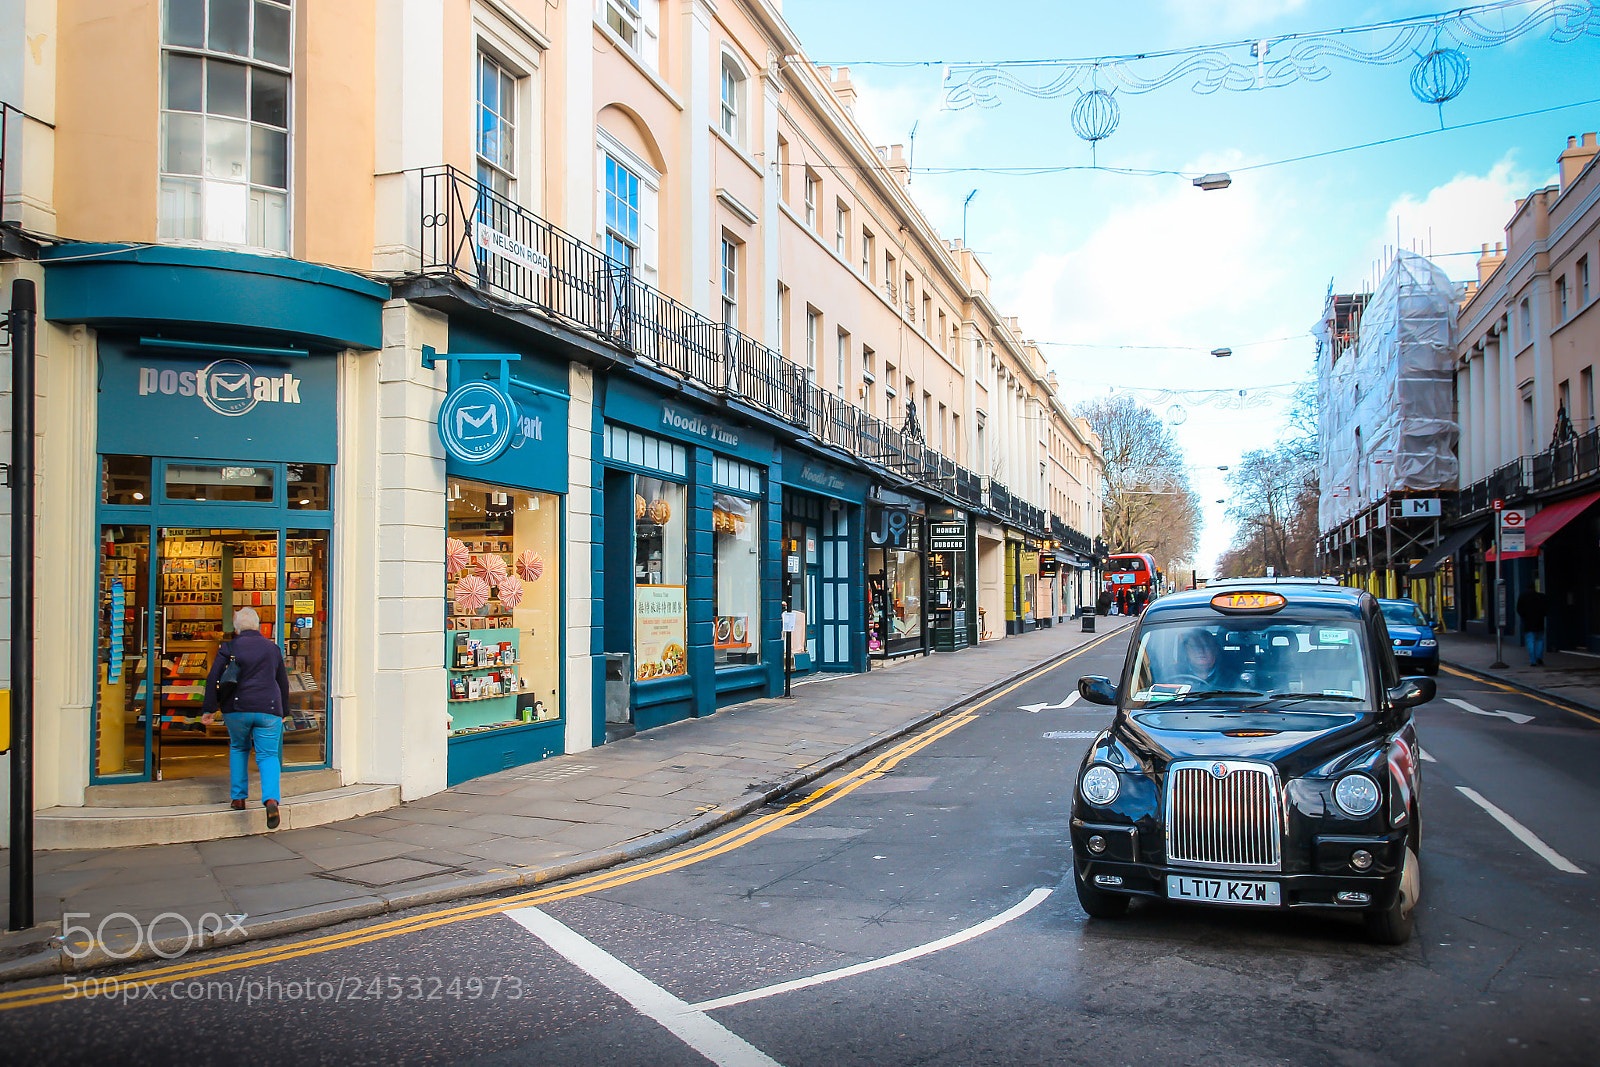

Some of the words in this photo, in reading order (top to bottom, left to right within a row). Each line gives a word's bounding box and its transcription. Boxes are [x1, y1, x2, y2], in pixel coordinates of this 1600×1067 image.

[493, 232, 525, 258] NELSON
[527, 250, 548, 269] ROAD
[662, 407, 708, 436] Noodle
[711, 423, 739, 446] Time
[801, 466, 828, 485] Noodle
[828, 475, 845, 490] Time
[1413, 500, 1430, 512] M
[1493, 500, 1501, 509] E
[871, 510, 907, 545] JOY
[1226, 595, 1269, 606] TAXI
[1179, 878, 1221, 899] LT17
[1227, 882, 1266, 901] KZW
